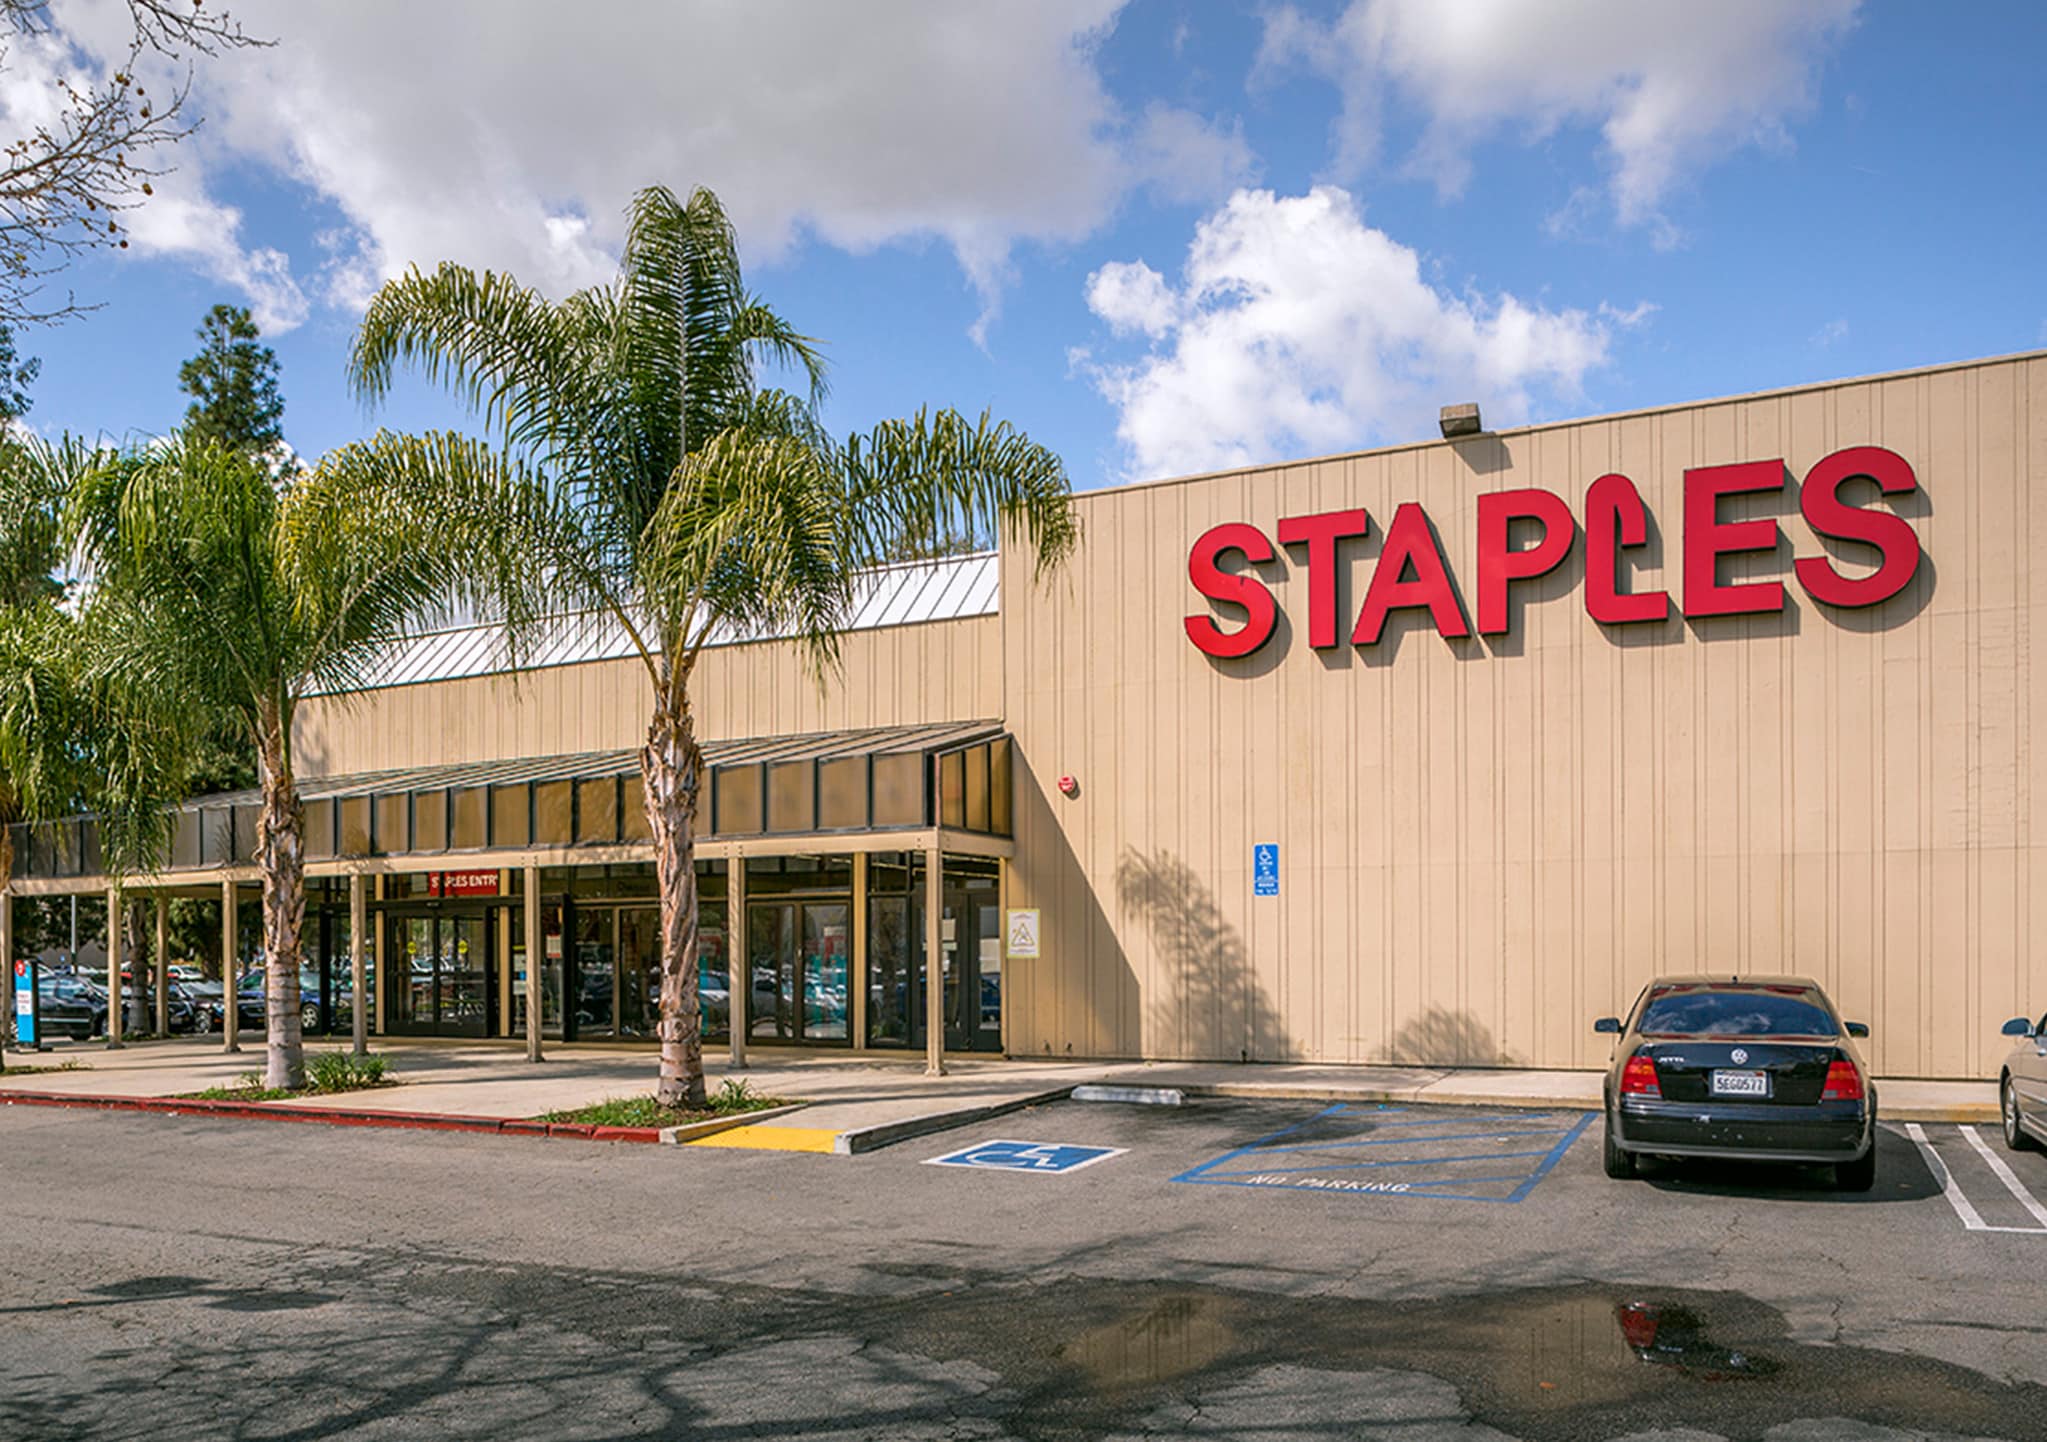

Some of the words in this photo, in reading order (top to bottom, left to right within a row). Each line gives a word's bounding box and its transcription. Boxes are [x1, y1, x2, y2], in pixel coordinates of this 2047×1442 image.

[1184, 446, 1921, 659] STAPLES
[469, 874, 498, 887] ENTR
[1247, 1174, 1288, 1185] NO
[1295, 1177, 1411, 1193] PARKING
